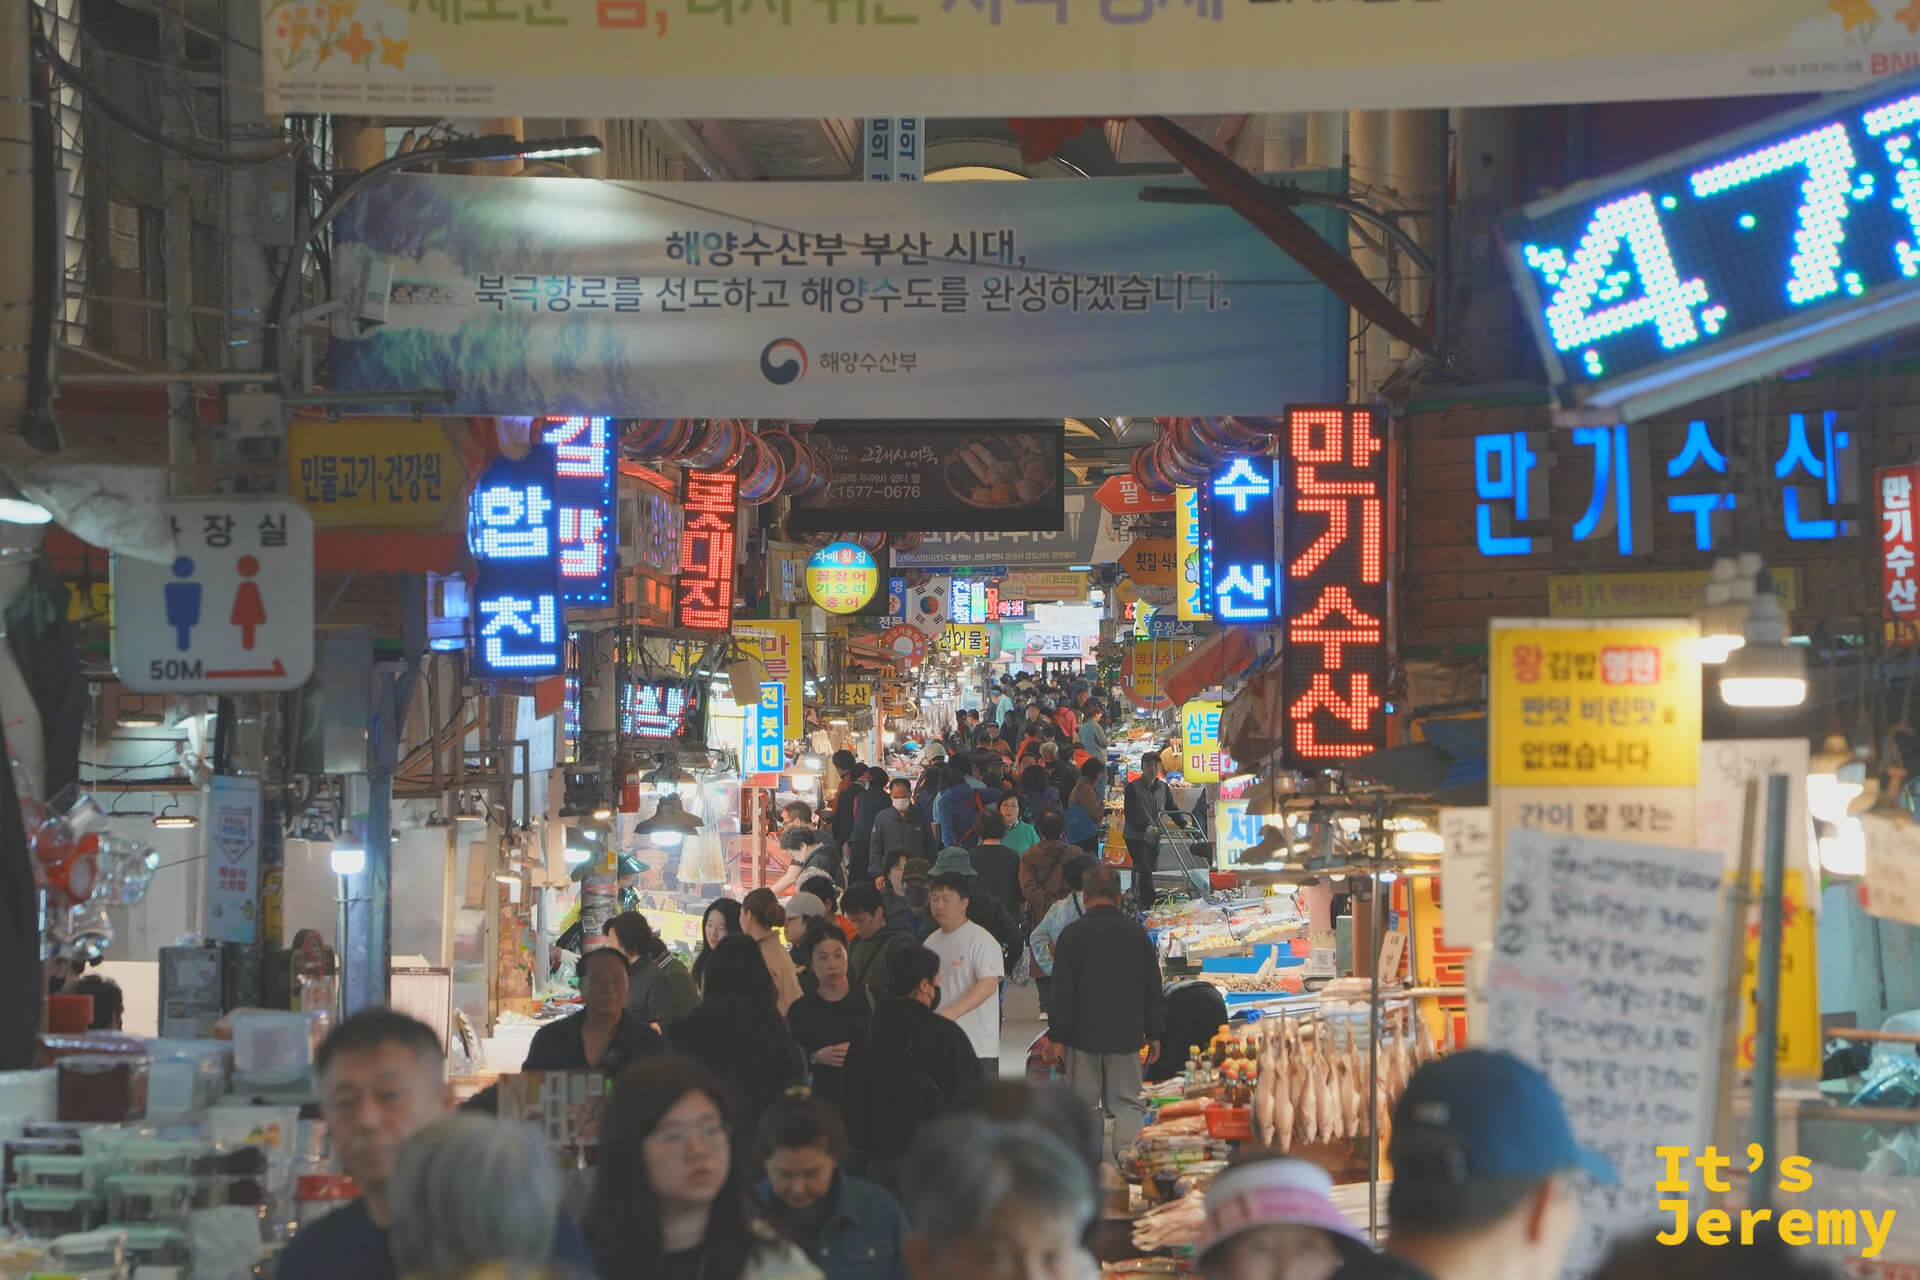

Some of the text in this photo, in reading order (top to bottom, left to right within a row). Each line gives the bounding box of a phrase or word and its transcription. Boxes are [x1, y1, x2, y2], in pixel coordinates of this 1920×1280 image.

[666, 230, 1028, 268] 해양수산부 부산 시대,
[475, 273, 1231, 314] 북극항로를 선도하고 해양수도를 완성하겠습니다.
[819, 351, 918, 374] 해양수산부
[838, 485, 921, 499] 1577-0676
[1475, 411, 1850, 556] 만기수산
[1214, 459, 1271, 617] 수산
[1882, 475, 1917, 613] 만기수산
[1290, 411, 1381, 757] 만기수산
[150, 660, 203, 681] 50M
